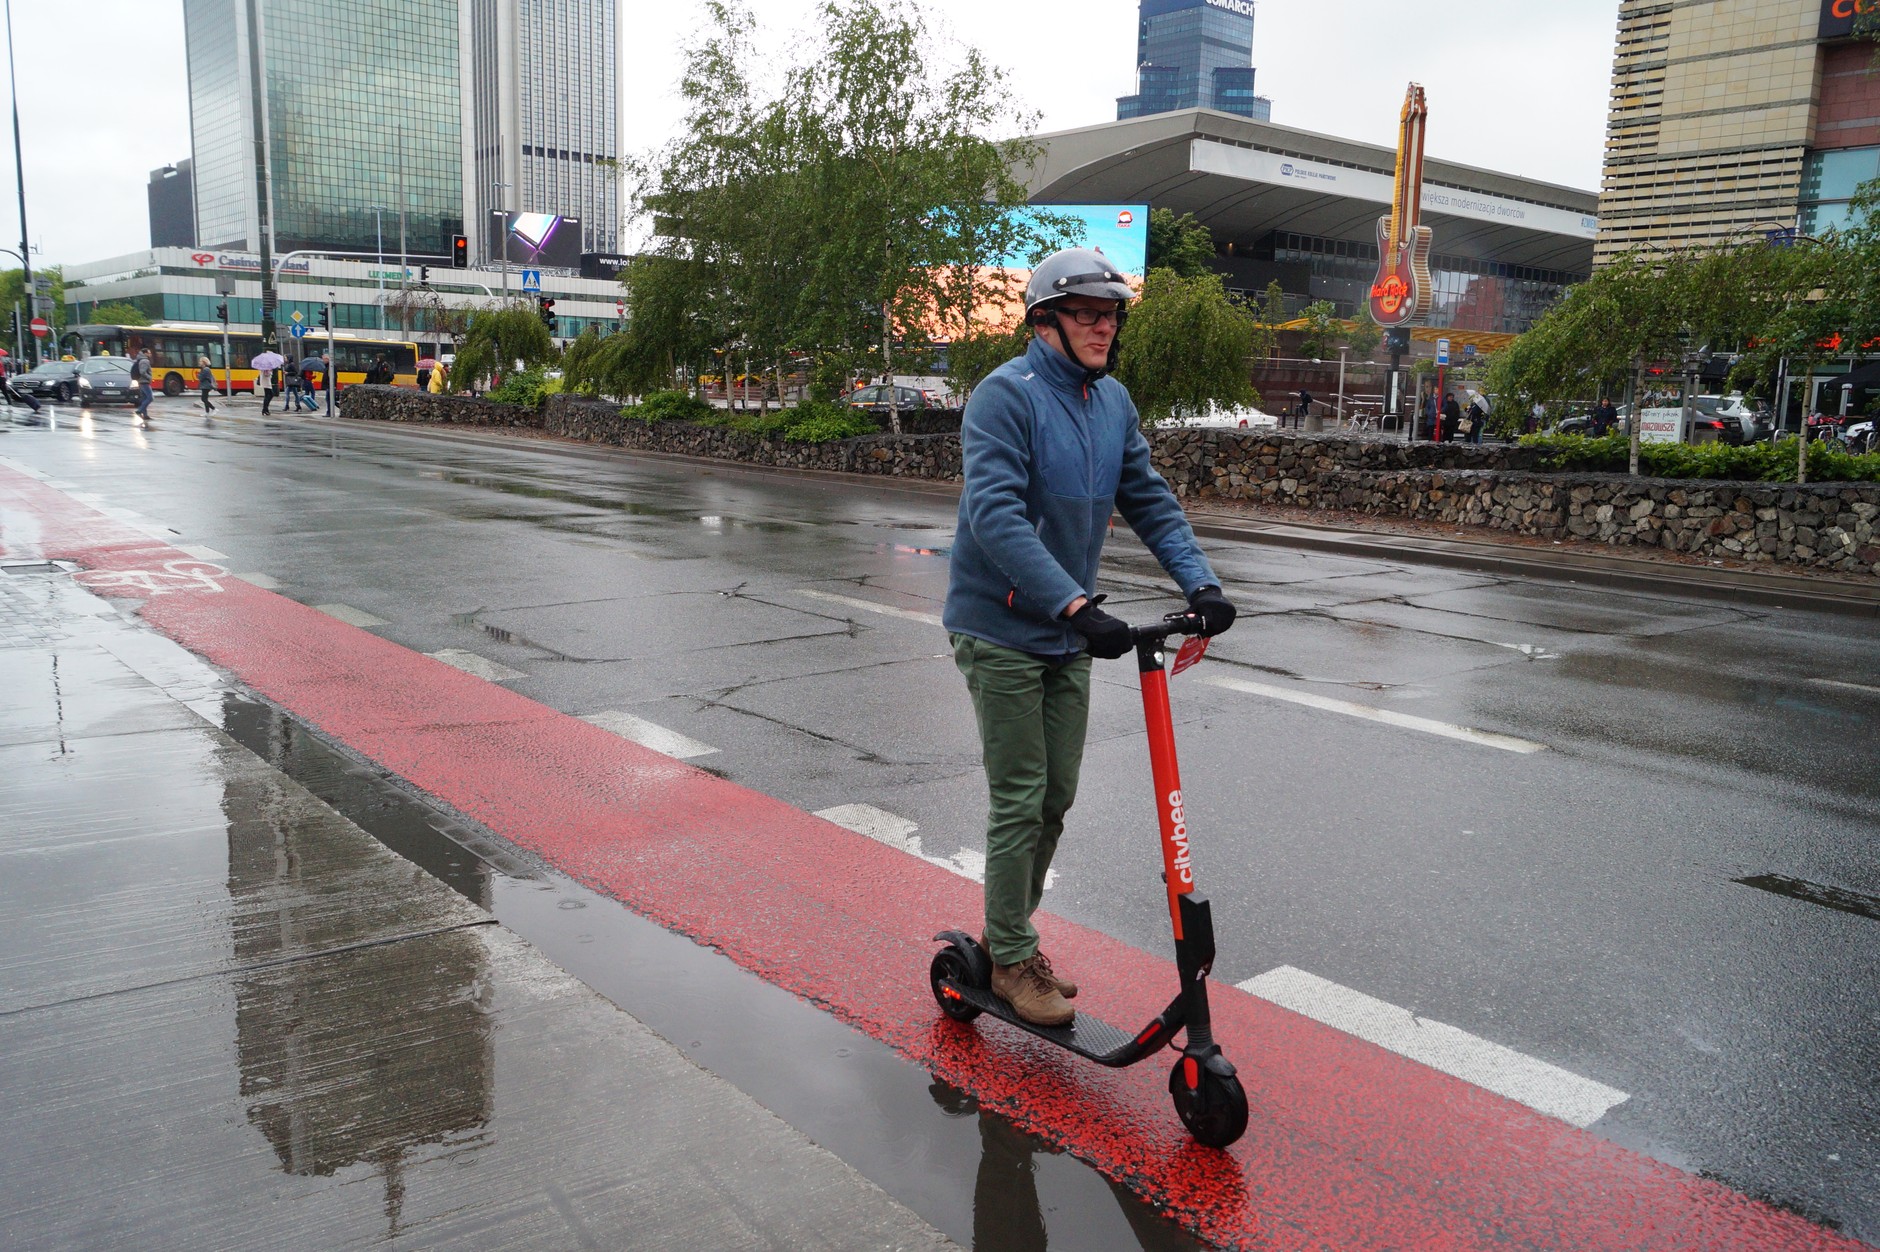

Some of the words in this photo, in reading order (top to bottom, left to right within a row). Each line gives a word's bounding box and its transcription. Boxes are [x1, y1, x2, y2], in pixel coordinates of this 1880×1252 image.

[1451, 197, 1496, 216] modernizacja
[1497, 204, 1525, 219] dworców
[219, 255, 261, 267] Casino
[1371, 284, 1389, 298] Hard
[1389, 282, 1408, 298] Rock
[1168, 789, 1192, 884] citybee
